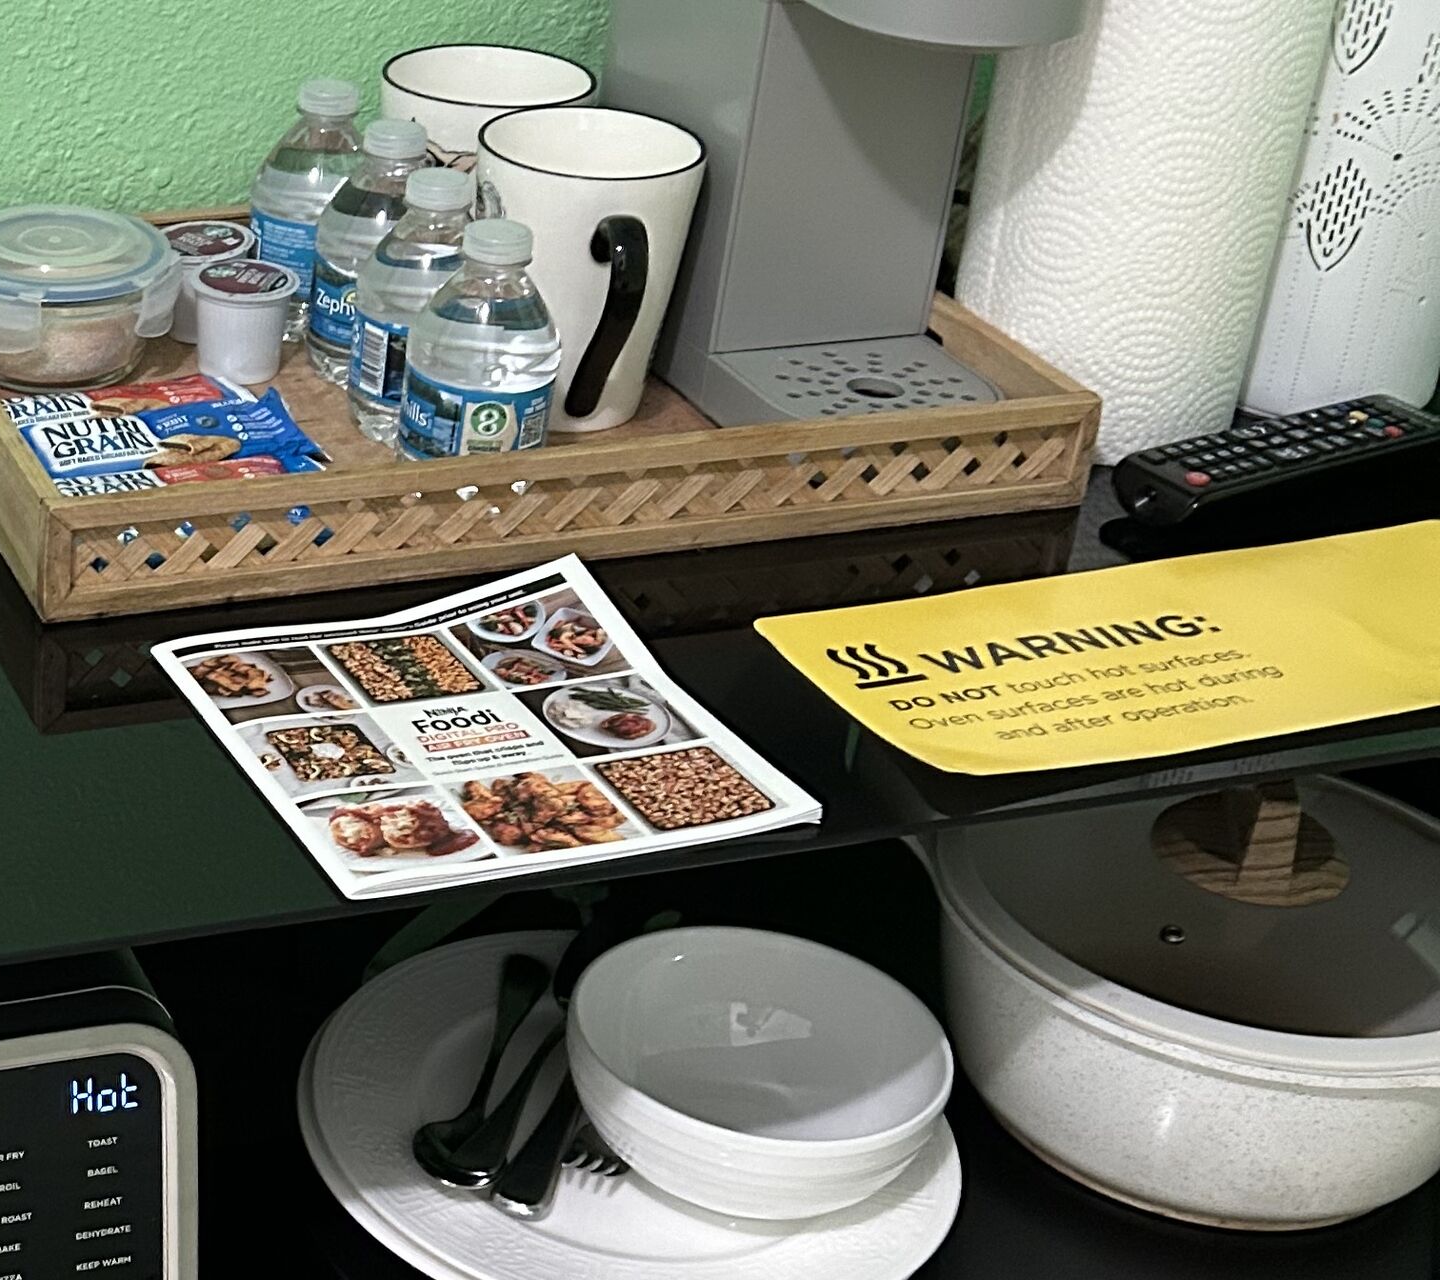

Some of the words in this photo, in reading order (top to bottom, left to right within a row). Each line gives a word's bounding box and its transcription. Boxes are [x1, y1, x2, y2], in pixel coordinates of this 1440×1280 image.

[42, 415, 142, 448] NUTRI
[53, 429, 155, 459] GRAIN
[917, 615, 1222, 673] WARNING:
[888, 696, 936, 712] DO
[939, 685, 1002, 704] NOT
[1005, 670, 1087, 694] touch
[1086, 664, 1137, 680] hot
[1138, 649, 1252, 674] surfaces.
[909, 712, 984, 730] Oven
[986, 692, 1099, 720] surfaces
[1101, 686, 1146, 702] are
[1146, 678, 1197, 695] hot
[1198, 664, 1285, 688] during
[412, 708, 502, 734] Foodi
[423, 705, 467, 719] NINJA
[995, 724, 1049, 740] and
[1052, 714, 1115, 733] after
[1121, 693, 1254, 722] operation.
[417, 729, 481, 744] DIGITAL
[484, 722, 520, 734] PRO
[72, 1072, 138, 1114] Hot
[87, 1136, 119, 1149] TOAST
[6, 1150, 25, 1161] FRY
[87, 1165, 119, 1178] BAGEL
[84, 1196, 123, 1210] REHEAT
[1, 1211, 33, 1224] ROAST
[75, 1224, 132, 1241] DEHYDRATE
[76, 1261, 101, 1272] KEEP
[102, 1255, 132, 1267] WARM
